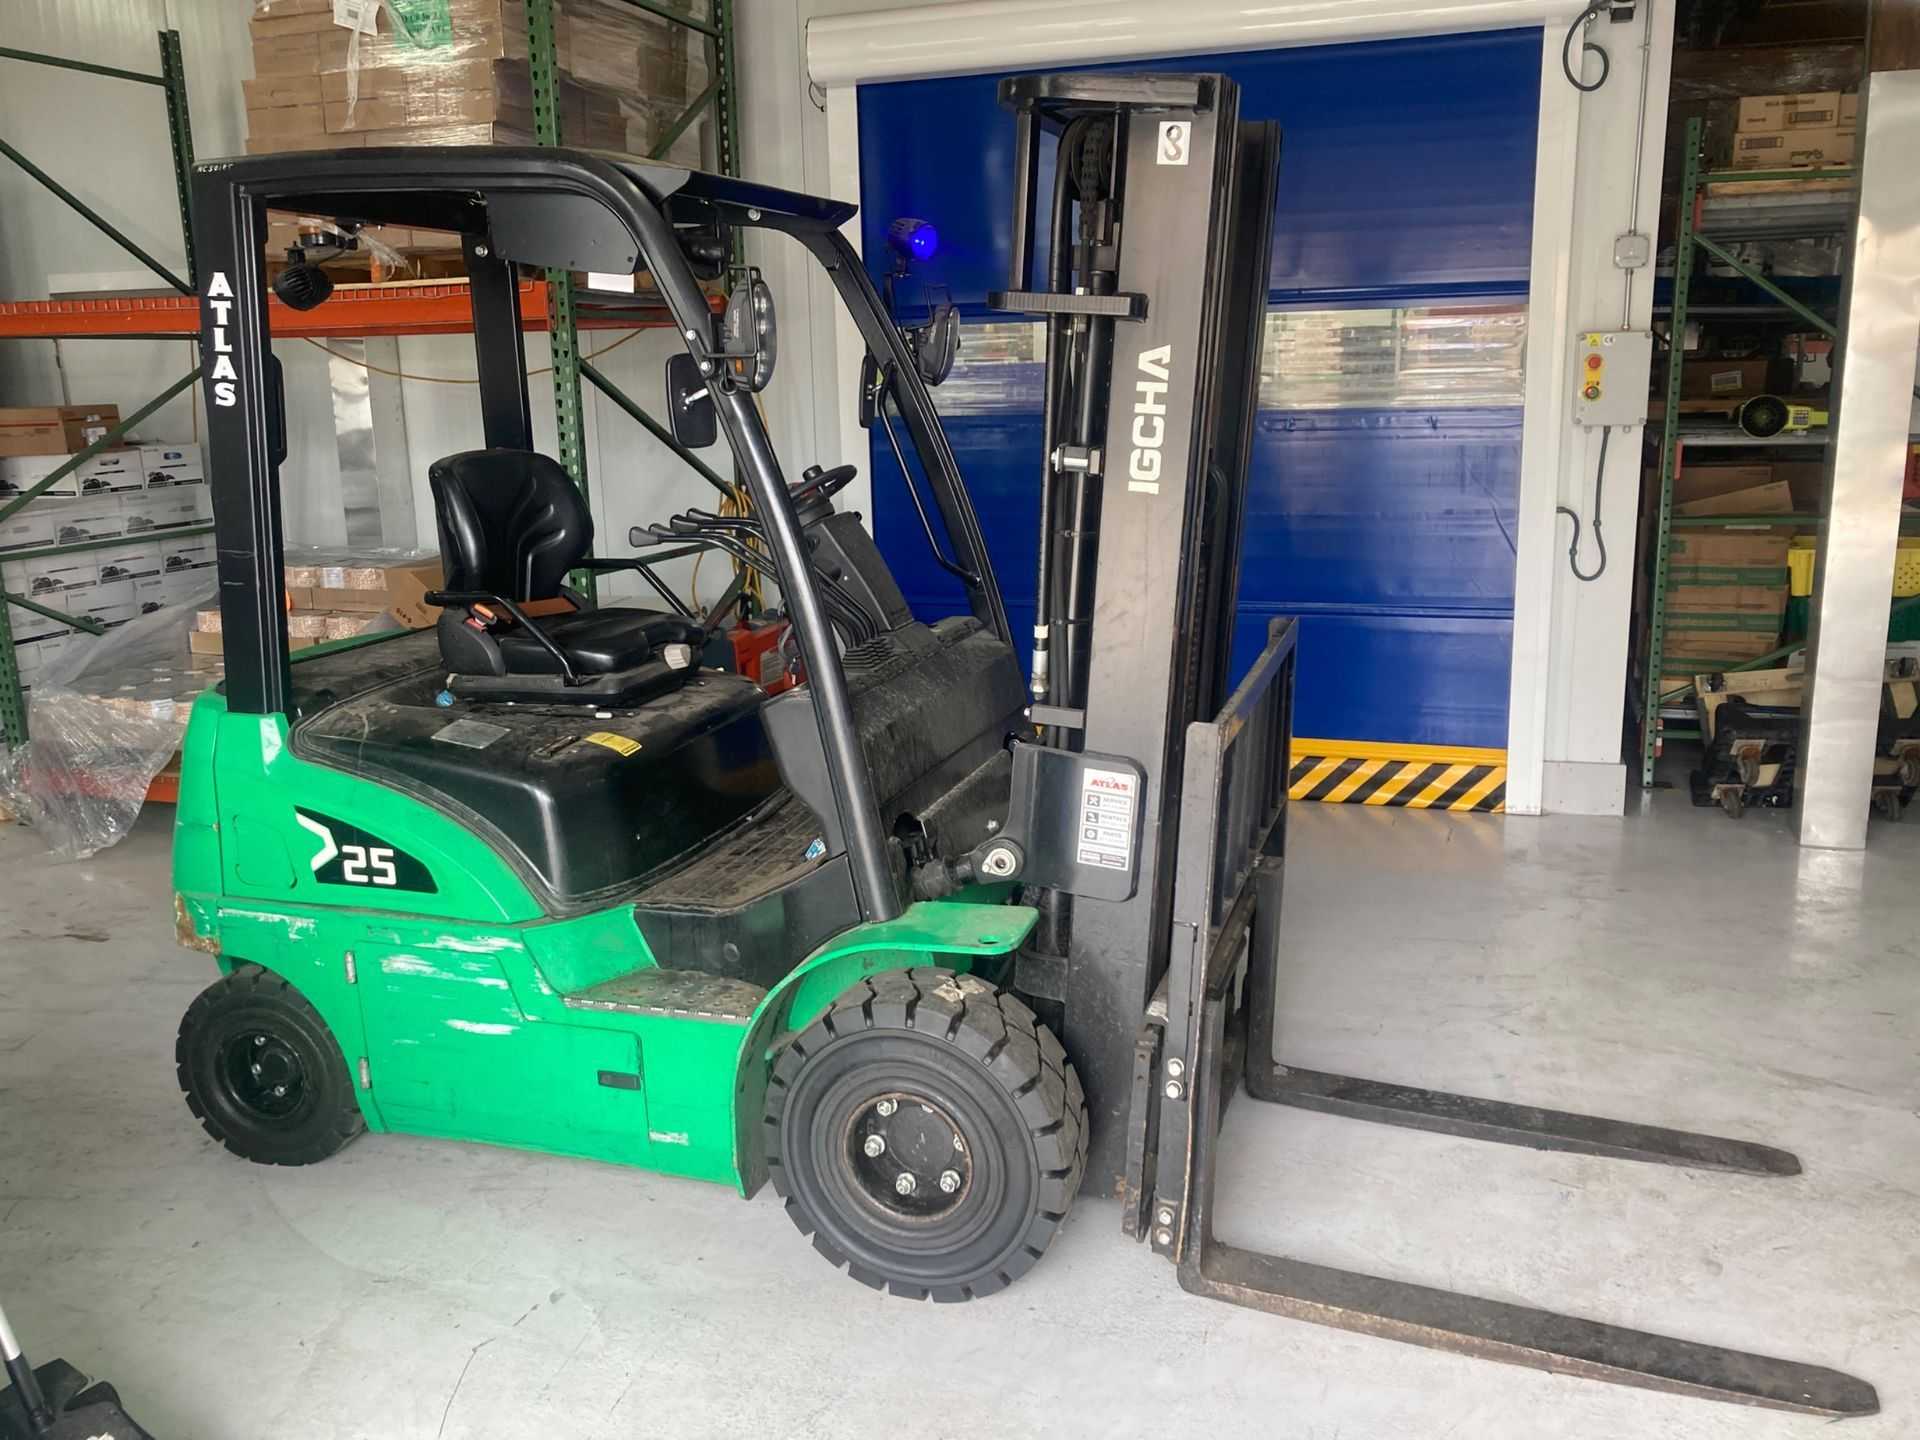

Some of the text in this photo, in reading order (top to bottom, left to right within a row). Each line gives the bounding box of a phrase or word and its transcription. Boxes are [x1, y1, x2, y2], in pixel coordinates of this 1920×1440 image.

[207, 271, 239, 407] ATLAS
[1090, 778, 1129, 791] ATLAS
[341, 844, 397, 886] 25
